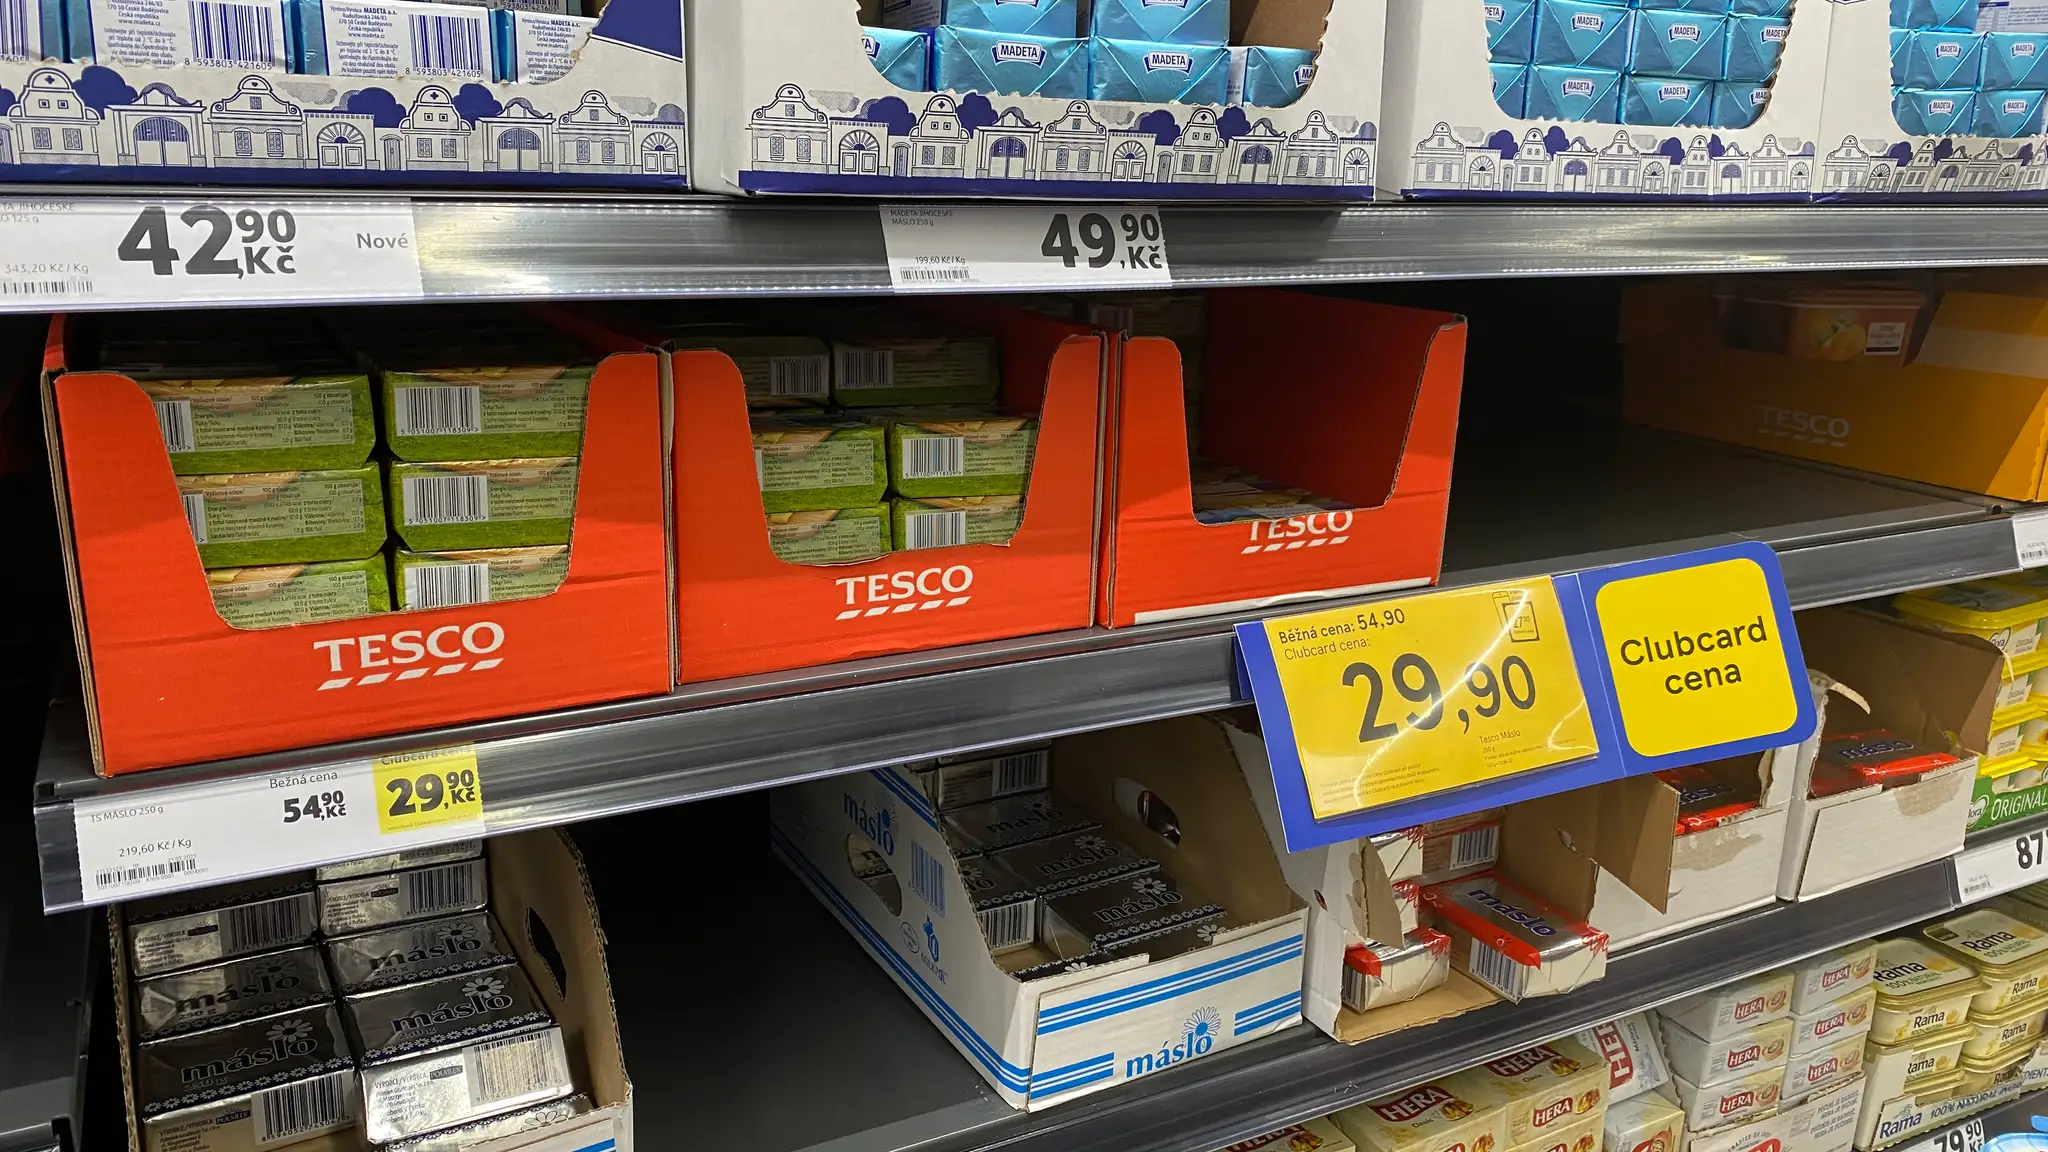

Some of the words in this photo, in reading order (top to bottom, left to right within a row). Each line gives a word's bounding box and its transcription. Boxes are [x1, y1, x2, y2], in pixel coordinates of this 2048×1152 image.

[363, 7, 387, 15] MADETA
[1575, 15, 1601, 29] MADETA
[1672, 26, 1698, 38] MADETA
[1000, 44, 1039, 59] MADETA
[1938, 43, 1959, 55] MADETA
[2014, 43, 2034, 54] MADETA
[197, 58, 234, 69] 593803
[237, 60, 273, 71] 421605
[1151, 53, 1187, 67] MADETA
[415, 67, 448, 77] 593803
[450, 68, 482, 78] 421605
[1566, 80, 1591, 93] MADETA
[1662, 84, 1687, 98] MADETA
[1931, 100, 1951, 111] MADETA
[2007, 100, 2026, 111] MADETA
[356, 232, 409, 250] Nové
[5, 263, 46, 274] 343,20
[1756, 404, 1850, 438] TESCO
[418, 516, 448, 525] 051007
[450, 515, 479, 524] 118309
[835, 564, 974, 605] TESCO
[1279, 625, 1318, 644] Běžná
[1320, 623, 1355, 637] cena:
[1356, 607, 1405, 632] 54,90
[313, 621, 505, 672] TESCO
[1284, 641, 1337, 660] Clubcard
[1339, 638, 1371, 651] cena:
[1619, 615, 1768, 666] Clubcard
[1665, 663, 1742, 695] cena
[1342, 652, 1536, 745] 29,90
[1479, 735, 1500, 744] Tesco
[1500, 729, 1521, 740] Máslo
[309, 771, 338, 782] cena
[91, 813, 101, 823] TS
[104, 808, 137, 821] MÁSLO
[139, 805, 156, 816] 250
[1991, 788, 2048, 821] ORIGINAL
[844, 792, 895, 857] máslo
[984, 804, 1064, 835] máslo
[119, 843, 155, 857] 219,60
[1037, 845, 1122, 877] máslo
[1093, 890, 1184, 924] máslo
[1467, 888, 1557, 938] máslo
[1961, 931, 2017, 953] Rama
[369, 936, 484, 970] máslo
[1823, 968, 1850, 987] HERA
[1873, 961, 1928, 982] Rama
[175, 974, 301, 1013] máslo
[2011, 976, 2038, 995] Rama
[391, 993, 513, 1034] máslo
[1735, 1001, 1763, 1018] HERA
[1815, 1016, 1844, 1035] HERA
[1913, 1011, 1946, 1029] Rama
[2001, 1022, 2028, 1041] Rama
[181, 1037, 319, 1084] máslo
[1126, 1032, 1214, 1079] máslo
[1498, 1045, 1553, 1076] HERA
[1729, 1049, 1759, 1067] HERA
[1809, 1062, 1837, 1080] HERA
[1379, 1087, 1450, 1122] HERA
[1535, 1102, 1572, 1126] HERA
[1722, 1095, 1752, 1114] HERA
[1411, 1117, 1434, 1129] Classic
[1879, 1111, 1923, 1140] Rama
